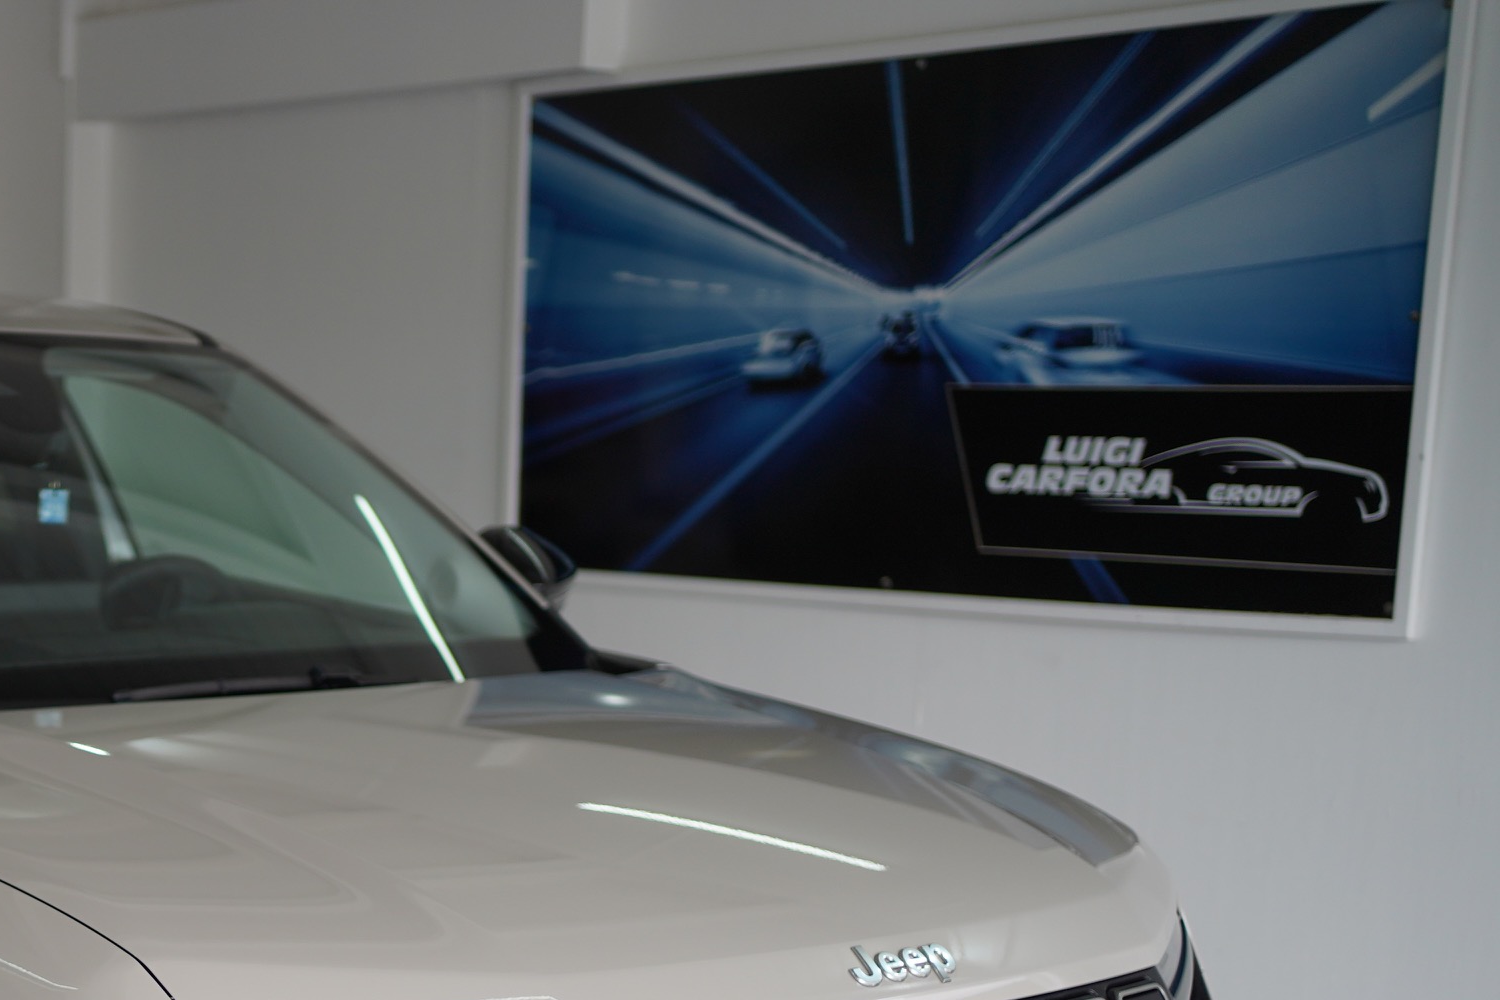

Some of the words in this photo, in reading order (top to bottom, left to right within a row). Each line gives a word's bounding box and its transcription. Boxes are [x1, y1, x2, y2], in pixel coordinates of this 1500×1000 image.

[1041, 434, 1147, 468] LUIGI
[985, 463, 1174, 500] CARFORA
[1206, 481, 1303, 507] GROUP
[848, 943, 957, 988] Jeep
